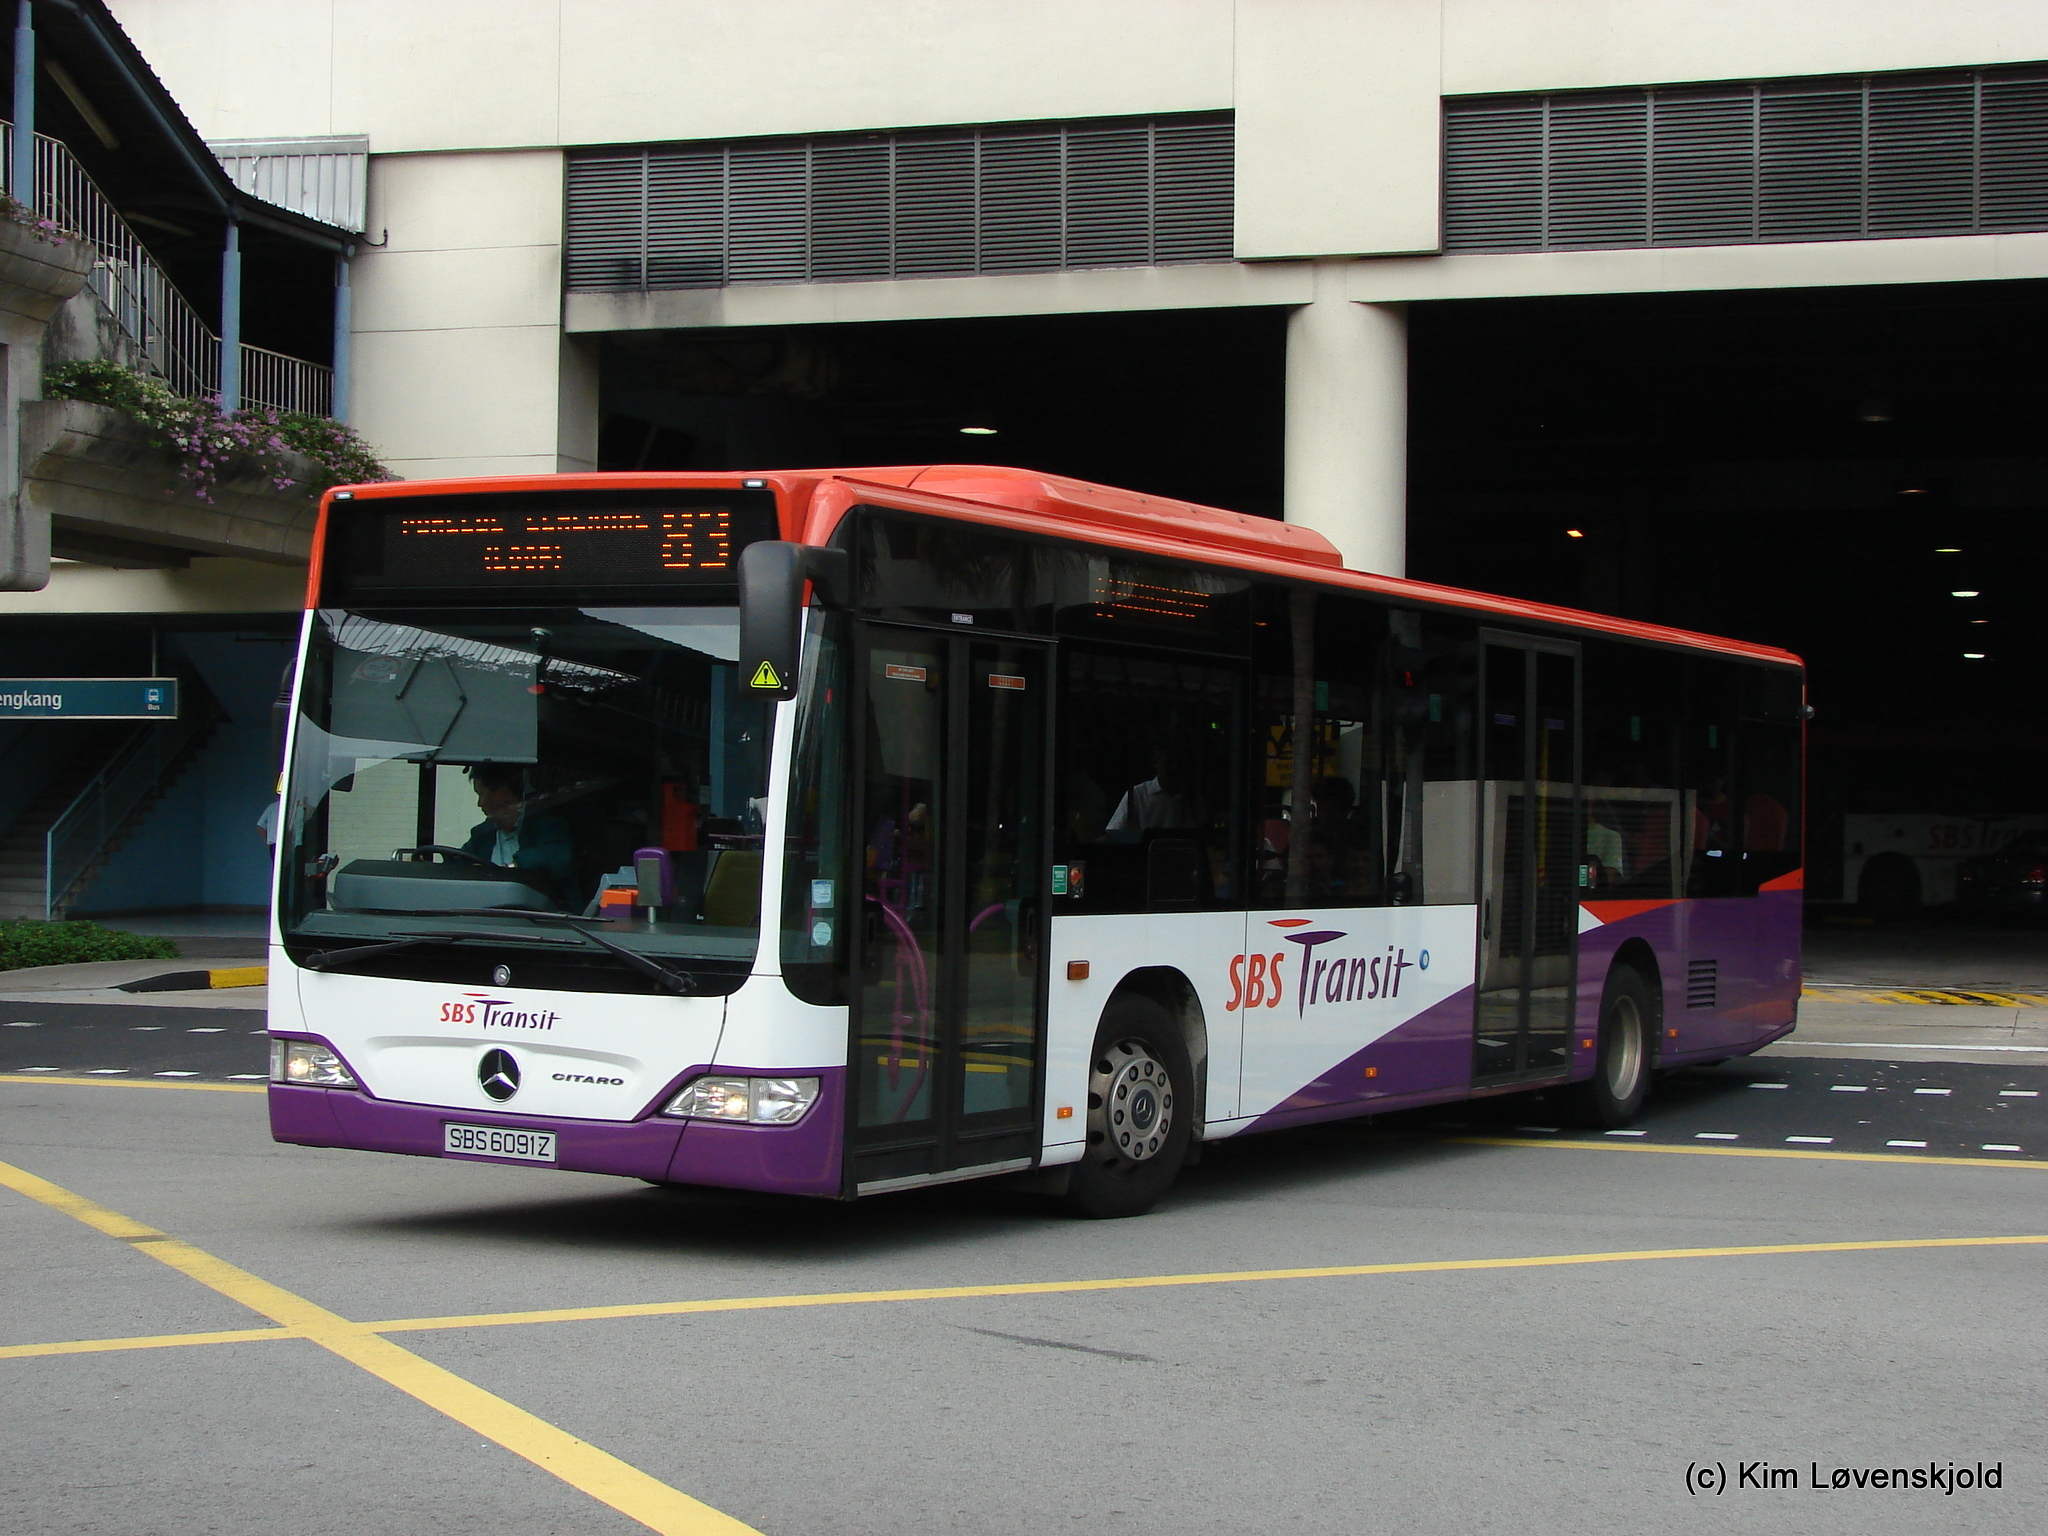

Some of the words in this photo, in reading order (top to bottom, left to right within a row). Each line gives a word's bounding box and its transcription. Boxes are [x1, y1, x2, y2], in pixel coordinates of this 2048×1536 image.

[0, 690, 62, 710] ngkang
[147, 703, 160, 711] Bus
[1928, 824, 1973, 850] SBS
[1225, 952, 1285, 1012] SBS
[1284, 930, 1414, 1020] Transit
[440, 1002, 476, 1024] SBS
[473, 999, 562, 1031] Transit
[551, 1073, 625, 1086] CITARO
